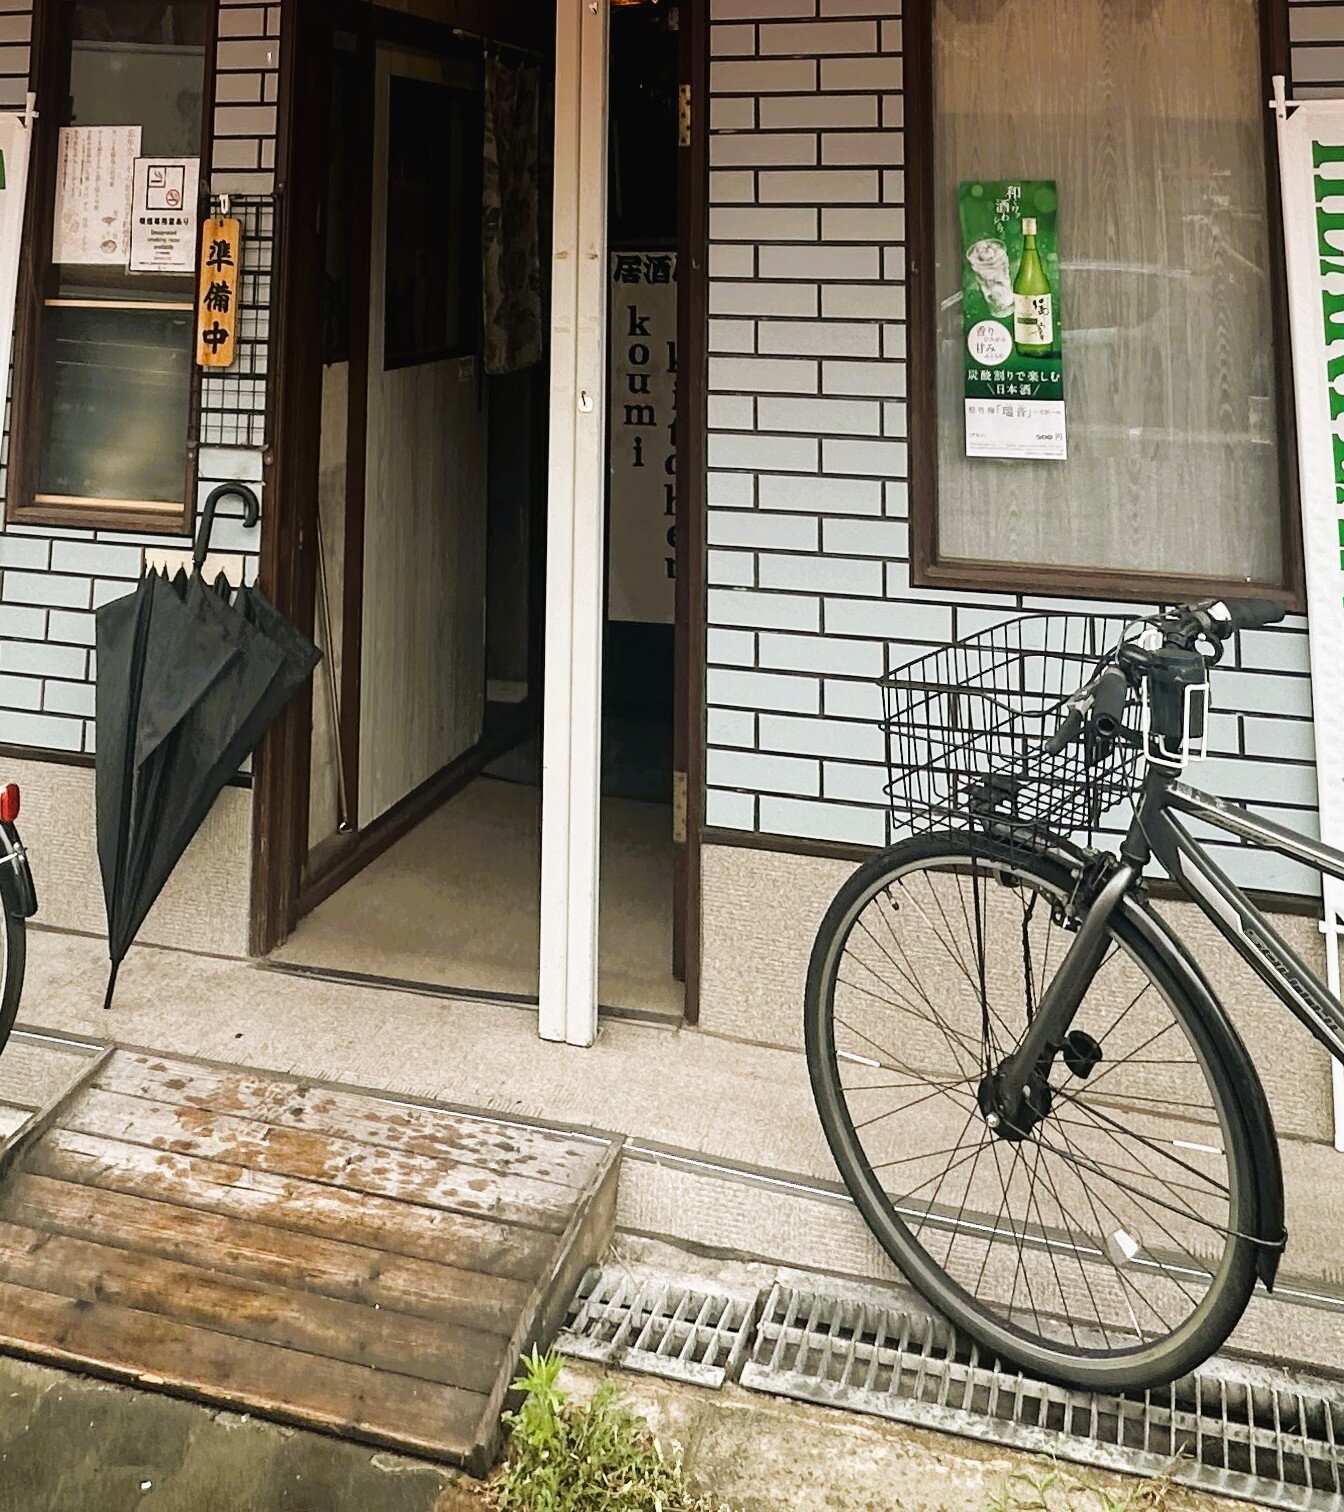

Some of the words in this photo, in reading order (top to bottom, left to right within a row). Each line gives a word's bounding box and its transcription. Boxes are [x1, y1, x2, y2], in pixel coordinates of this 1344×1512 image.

[612, 254, 677, 285] 居酒
[202, 239, 235, 355] 準備中
[622, 305, 657, 468] koumi
[967, 369, 1060, 382] 炭酸割りで楽しむ
[996, 384, 1032, 396] 日本酒
